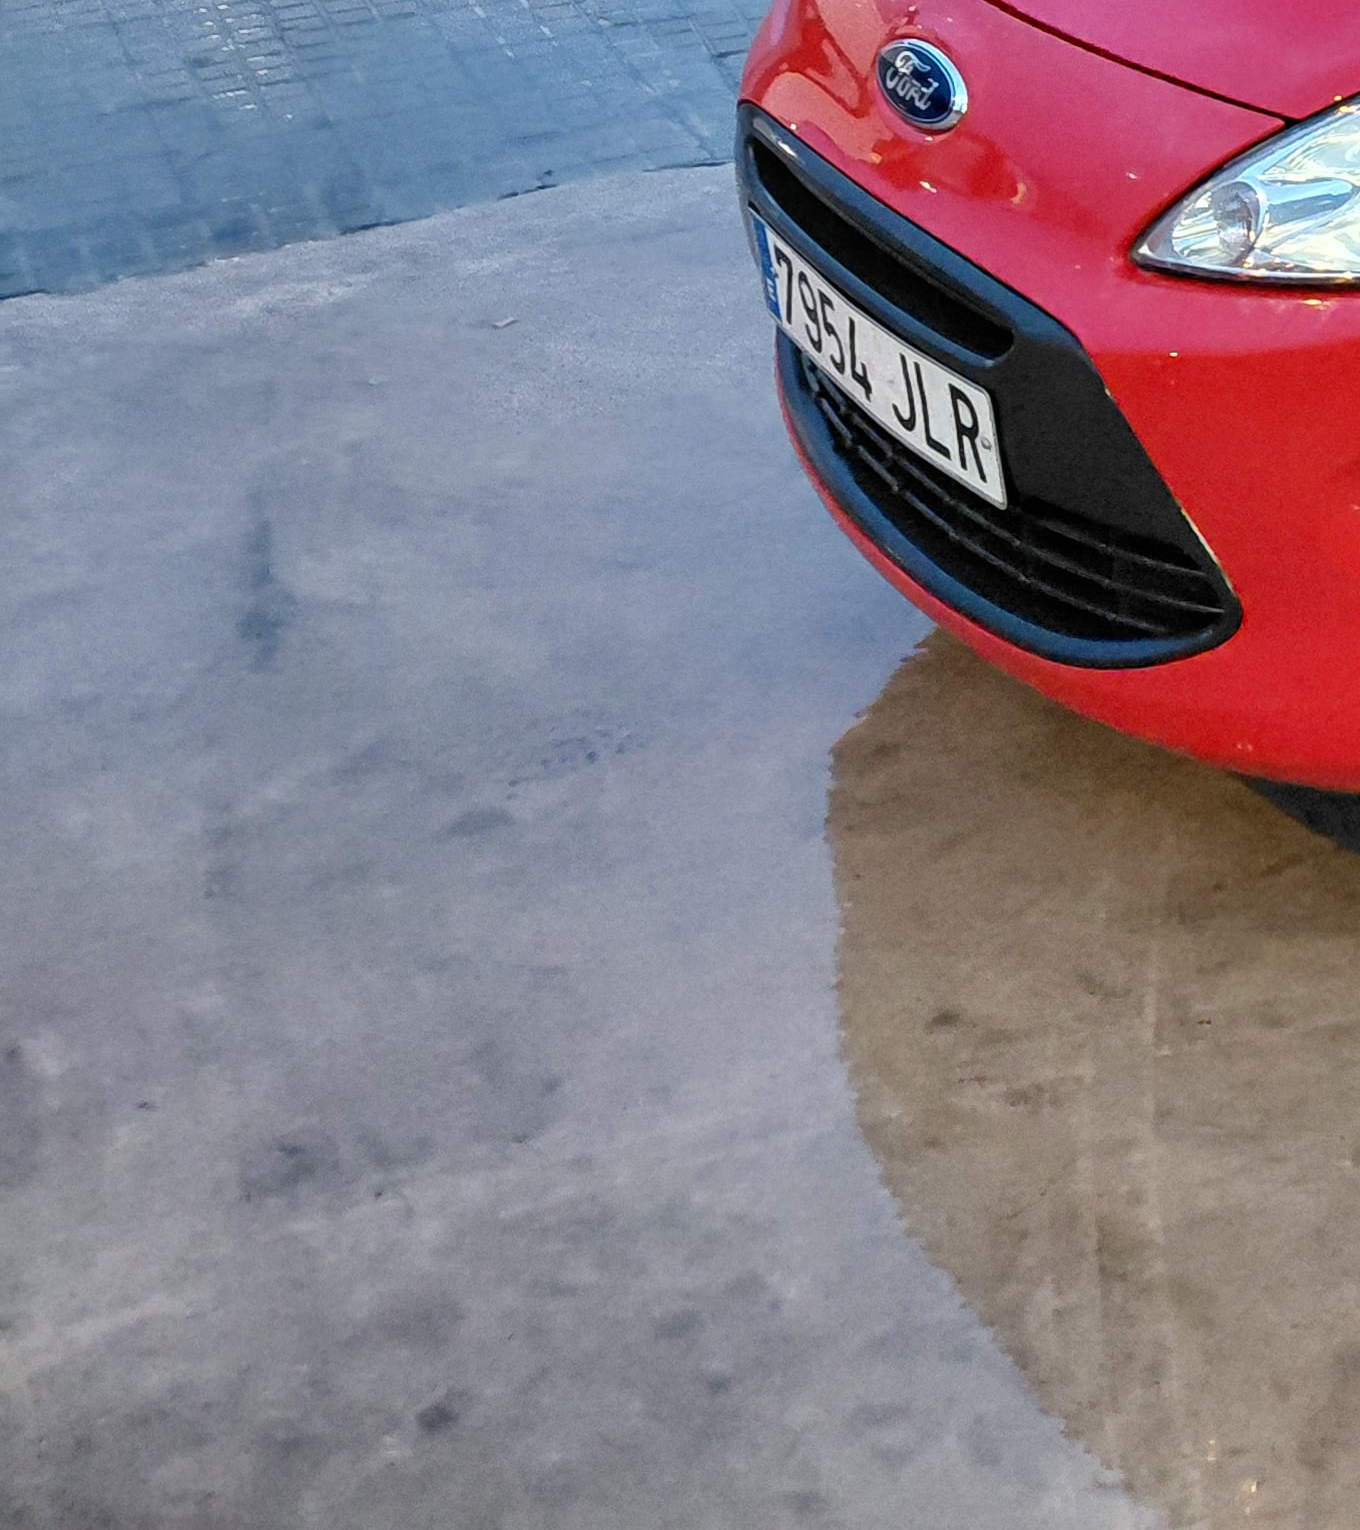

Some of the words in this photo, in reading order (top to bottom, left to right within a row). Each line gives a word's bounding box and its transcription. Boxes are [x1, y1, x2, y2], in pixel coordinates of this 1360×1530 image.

[885, 50, 940, 111] Ford
[773, 243, 874, 403] 7954
[891, 351, 988, 484] JLR
